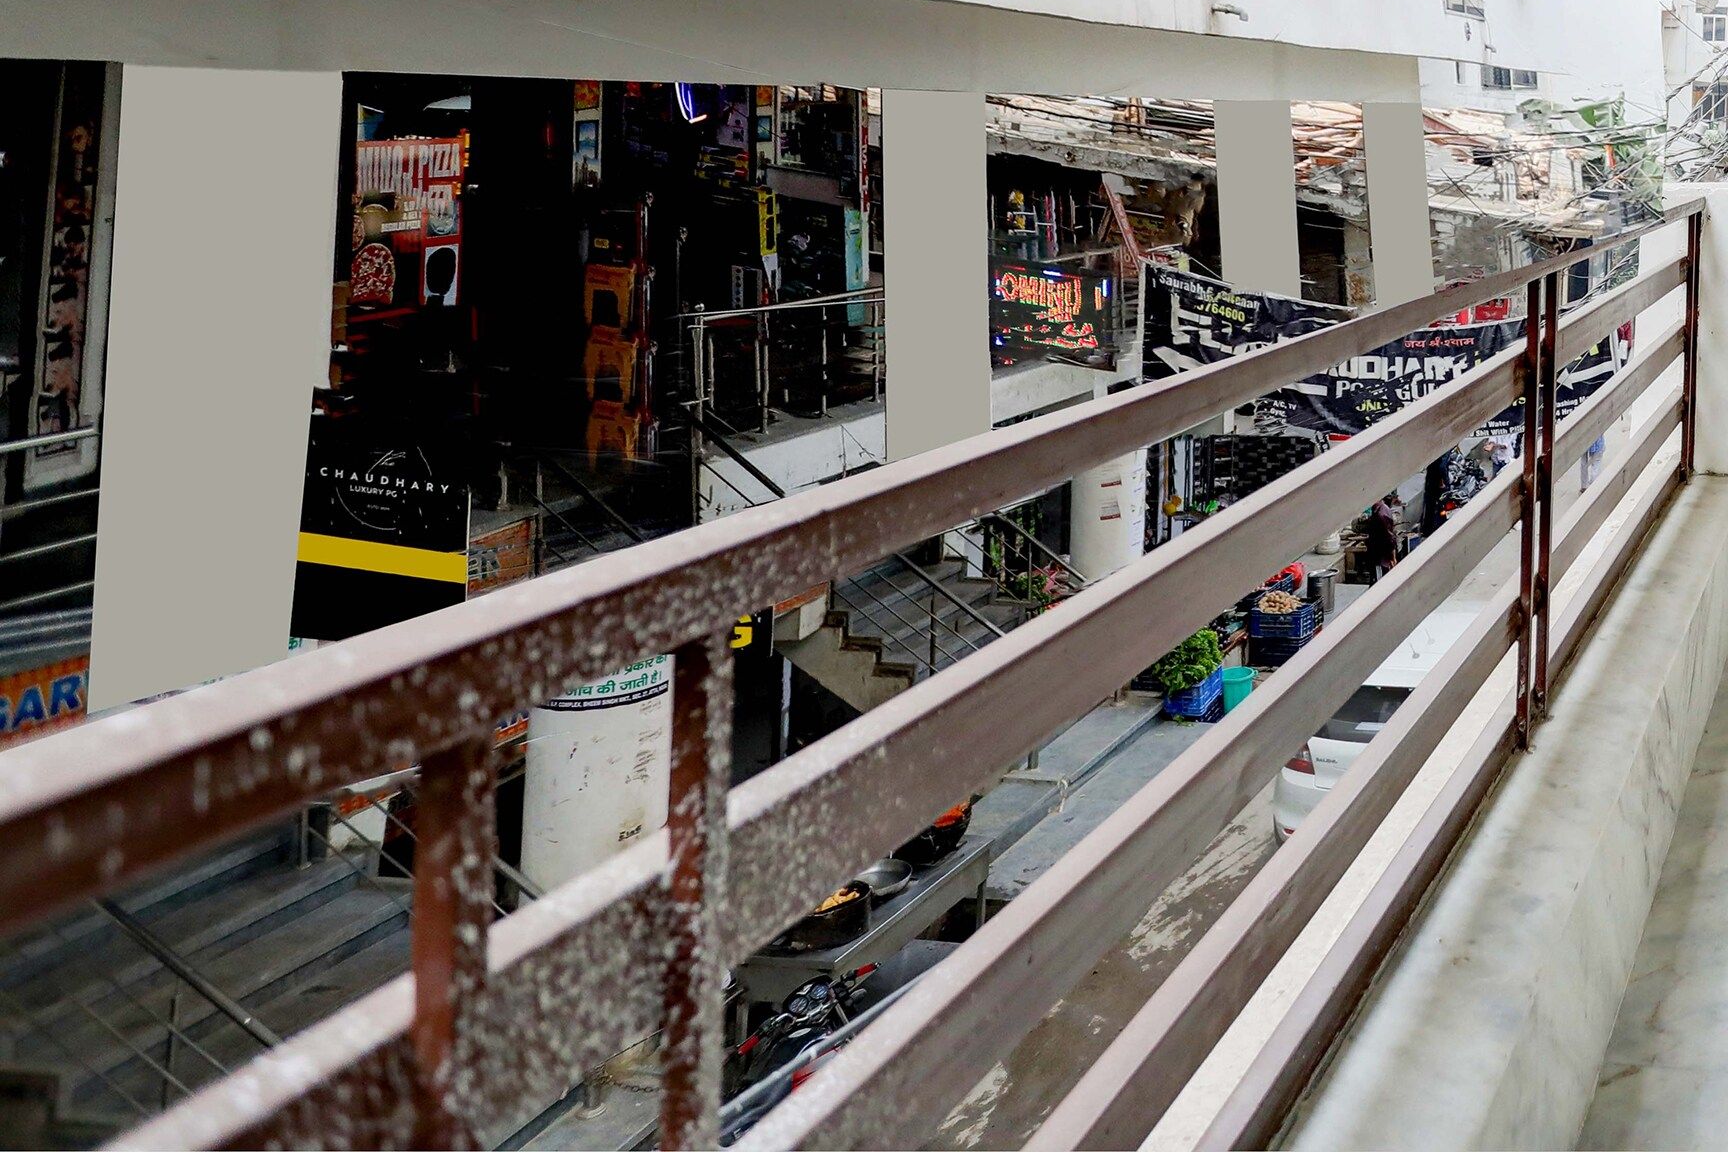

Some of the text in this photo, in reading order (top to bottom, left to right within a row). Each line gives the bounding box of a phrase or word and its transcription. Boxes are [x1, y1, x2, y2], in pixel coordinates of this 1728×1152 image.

[418, 143, 461, 179] PIZZA
[1404, 339, 1426, 348] जय
[320, 467, 449, 494] CHAUDHARY
[350, 484, 398, 498] LUXURY PG
[597, 679, 616, 695] की
[620, 674, 649, 691] जाती
